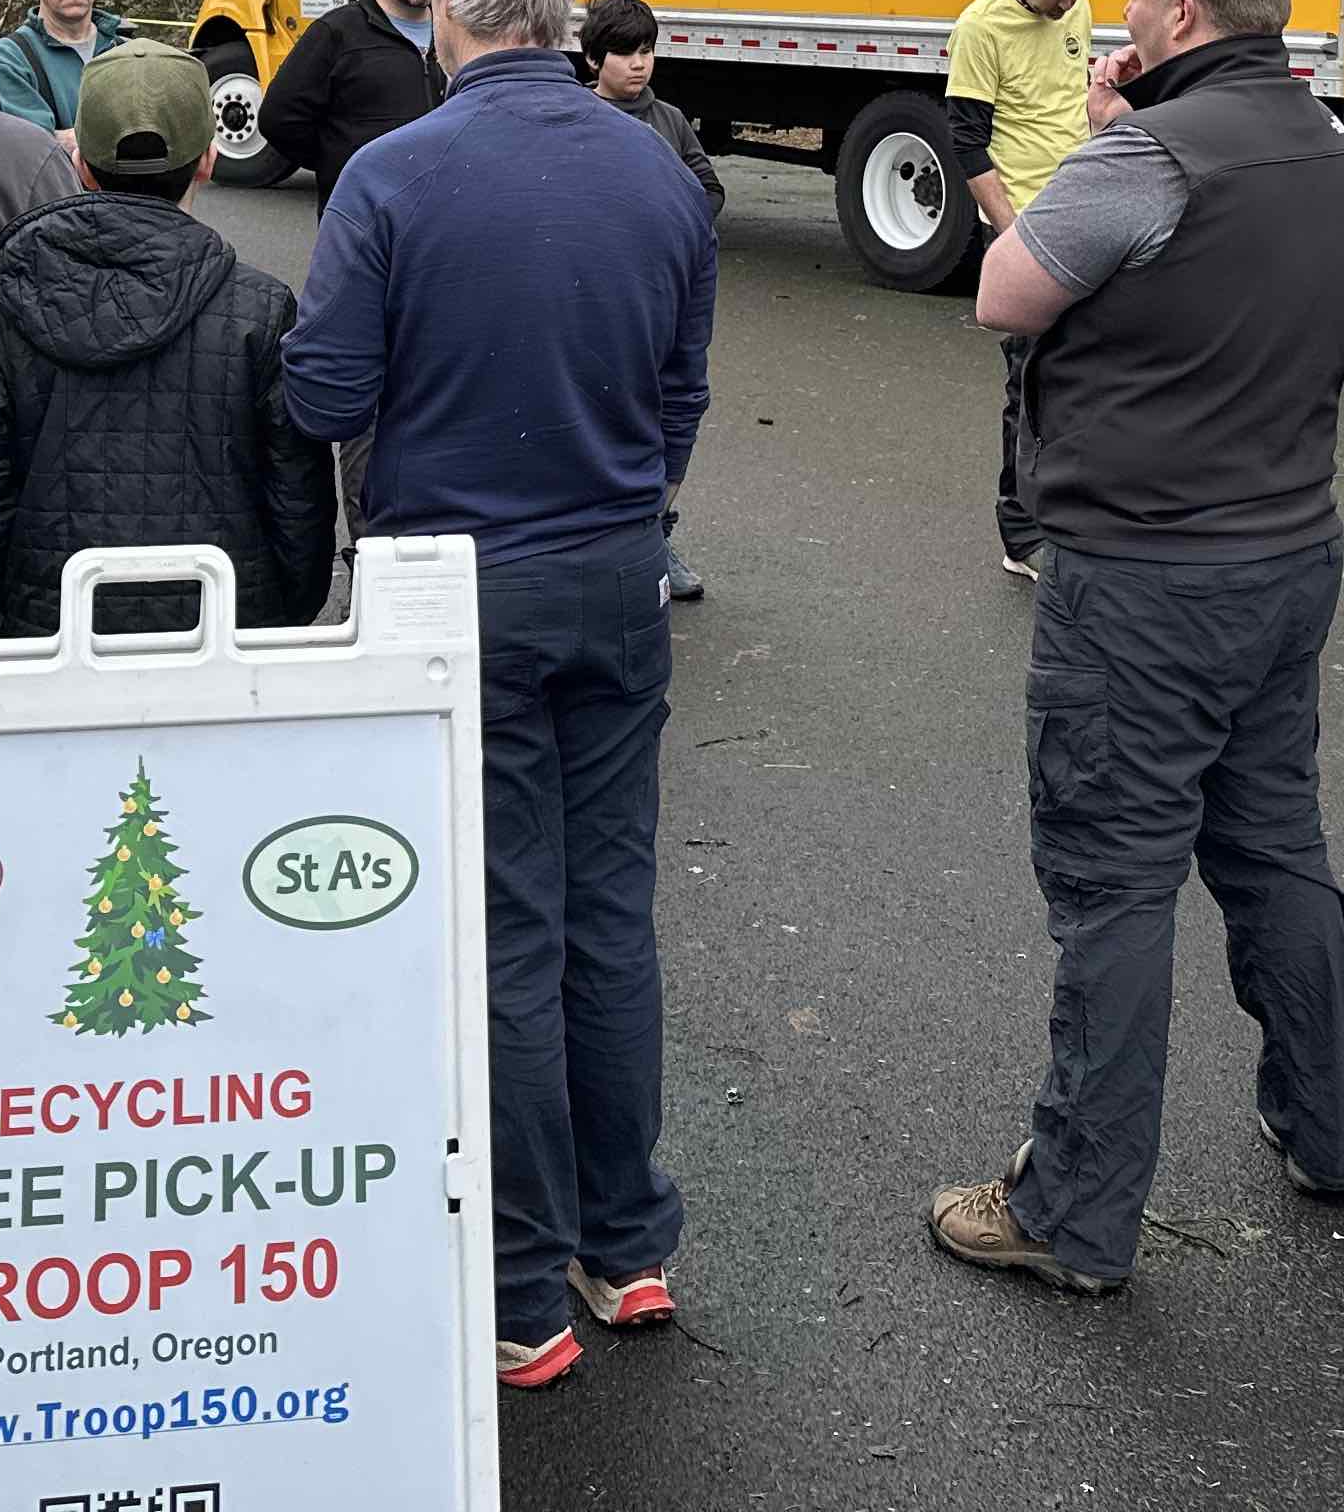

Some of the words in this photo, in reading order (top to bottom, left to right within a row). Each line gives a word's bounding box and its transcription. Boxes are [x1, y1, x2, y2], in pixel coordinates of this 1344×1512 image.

[275, 850, 319, 894] St
[327, 850, 393, 891] A's
[94, 1143, 396, 1222] PICK-UP
[221, 1238, 339, 1305] 150
[151, 1327, 278, 1367] Oregon
